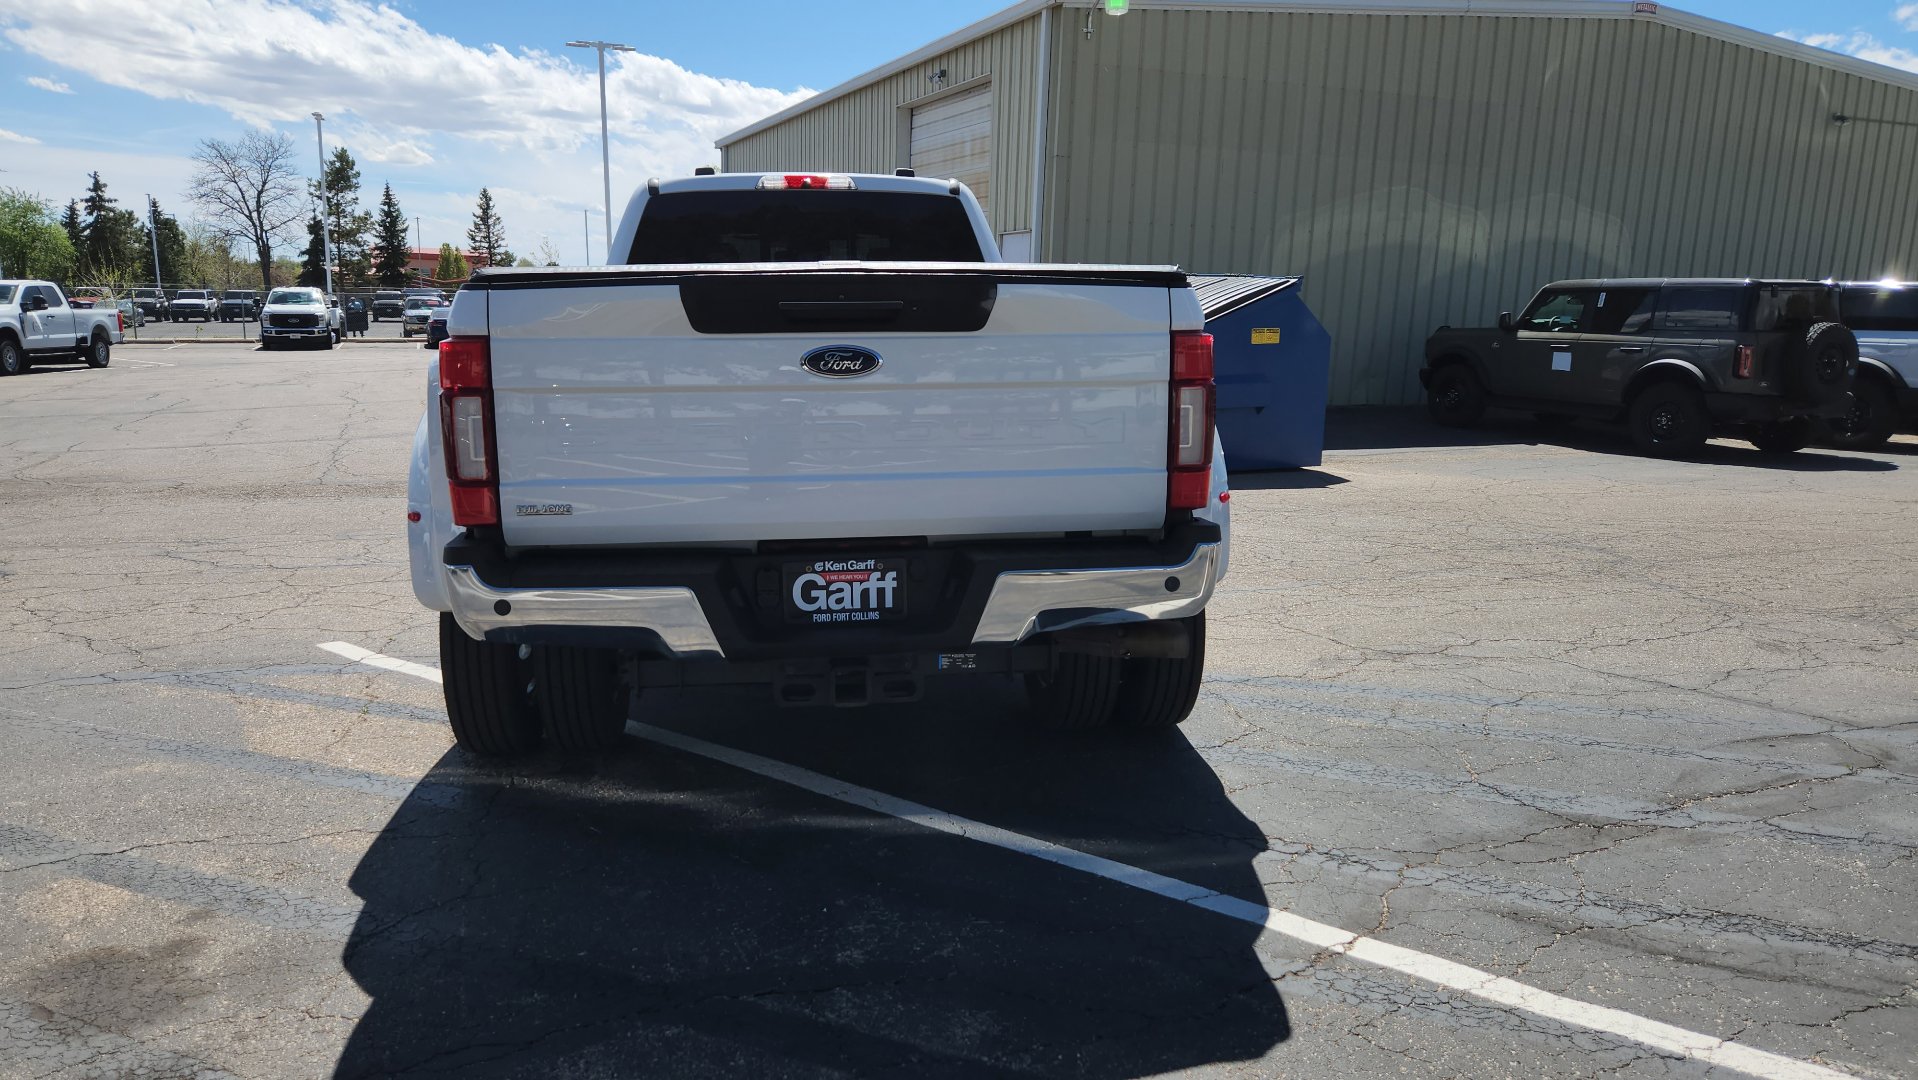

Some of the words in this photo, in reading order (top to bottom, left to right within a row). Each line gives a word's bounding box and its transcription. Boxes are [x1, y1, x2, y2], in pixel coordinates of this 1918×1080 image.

[820, 351, 864, 371] Ford
[825, 560, 847, 571] Ken
[847, 559, 876, 571] Garff
[793, 571, 897, 611] Garff
[813, 613, 831, 622] FORD
[832, 613, 850, 622] FORT
[851, 611, 879, 621] COLLINS
